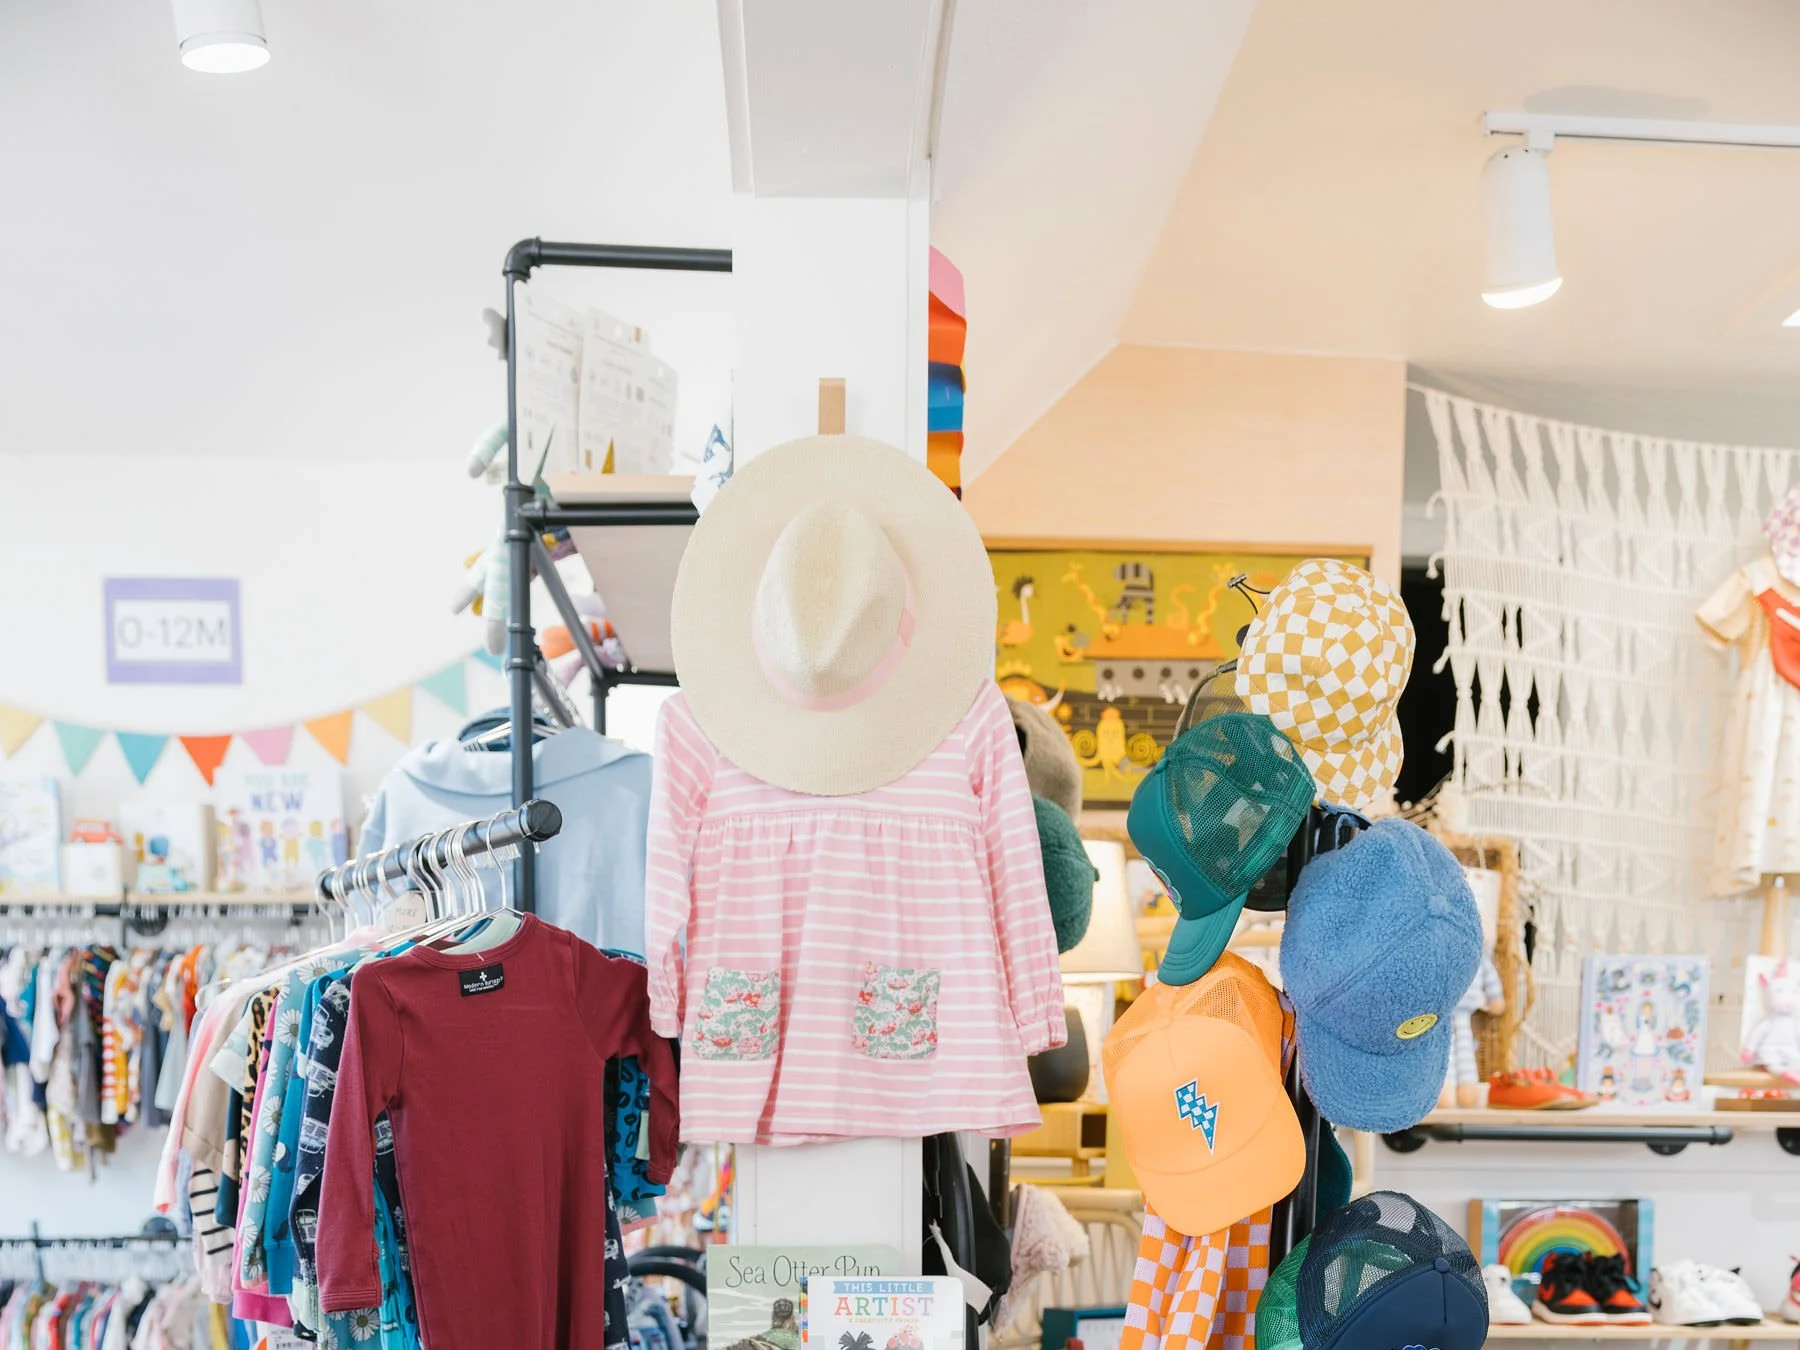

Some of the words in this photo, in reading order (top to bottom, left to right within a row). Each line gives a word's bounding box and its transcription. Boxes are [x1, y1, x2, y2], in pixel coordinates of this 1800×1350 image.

[117, 616, 227, 649] 0-12M
[251, 789, 303, 811] NEW
[725, 1256, 766, 1288] Sea
[773, 1255, 830, 1287] Otter
[843, 1283, 872, 1293] THIS
[879, 1282, 924, 1293] LITTLE
[834, 1297, 934, 1316] ARTIST
